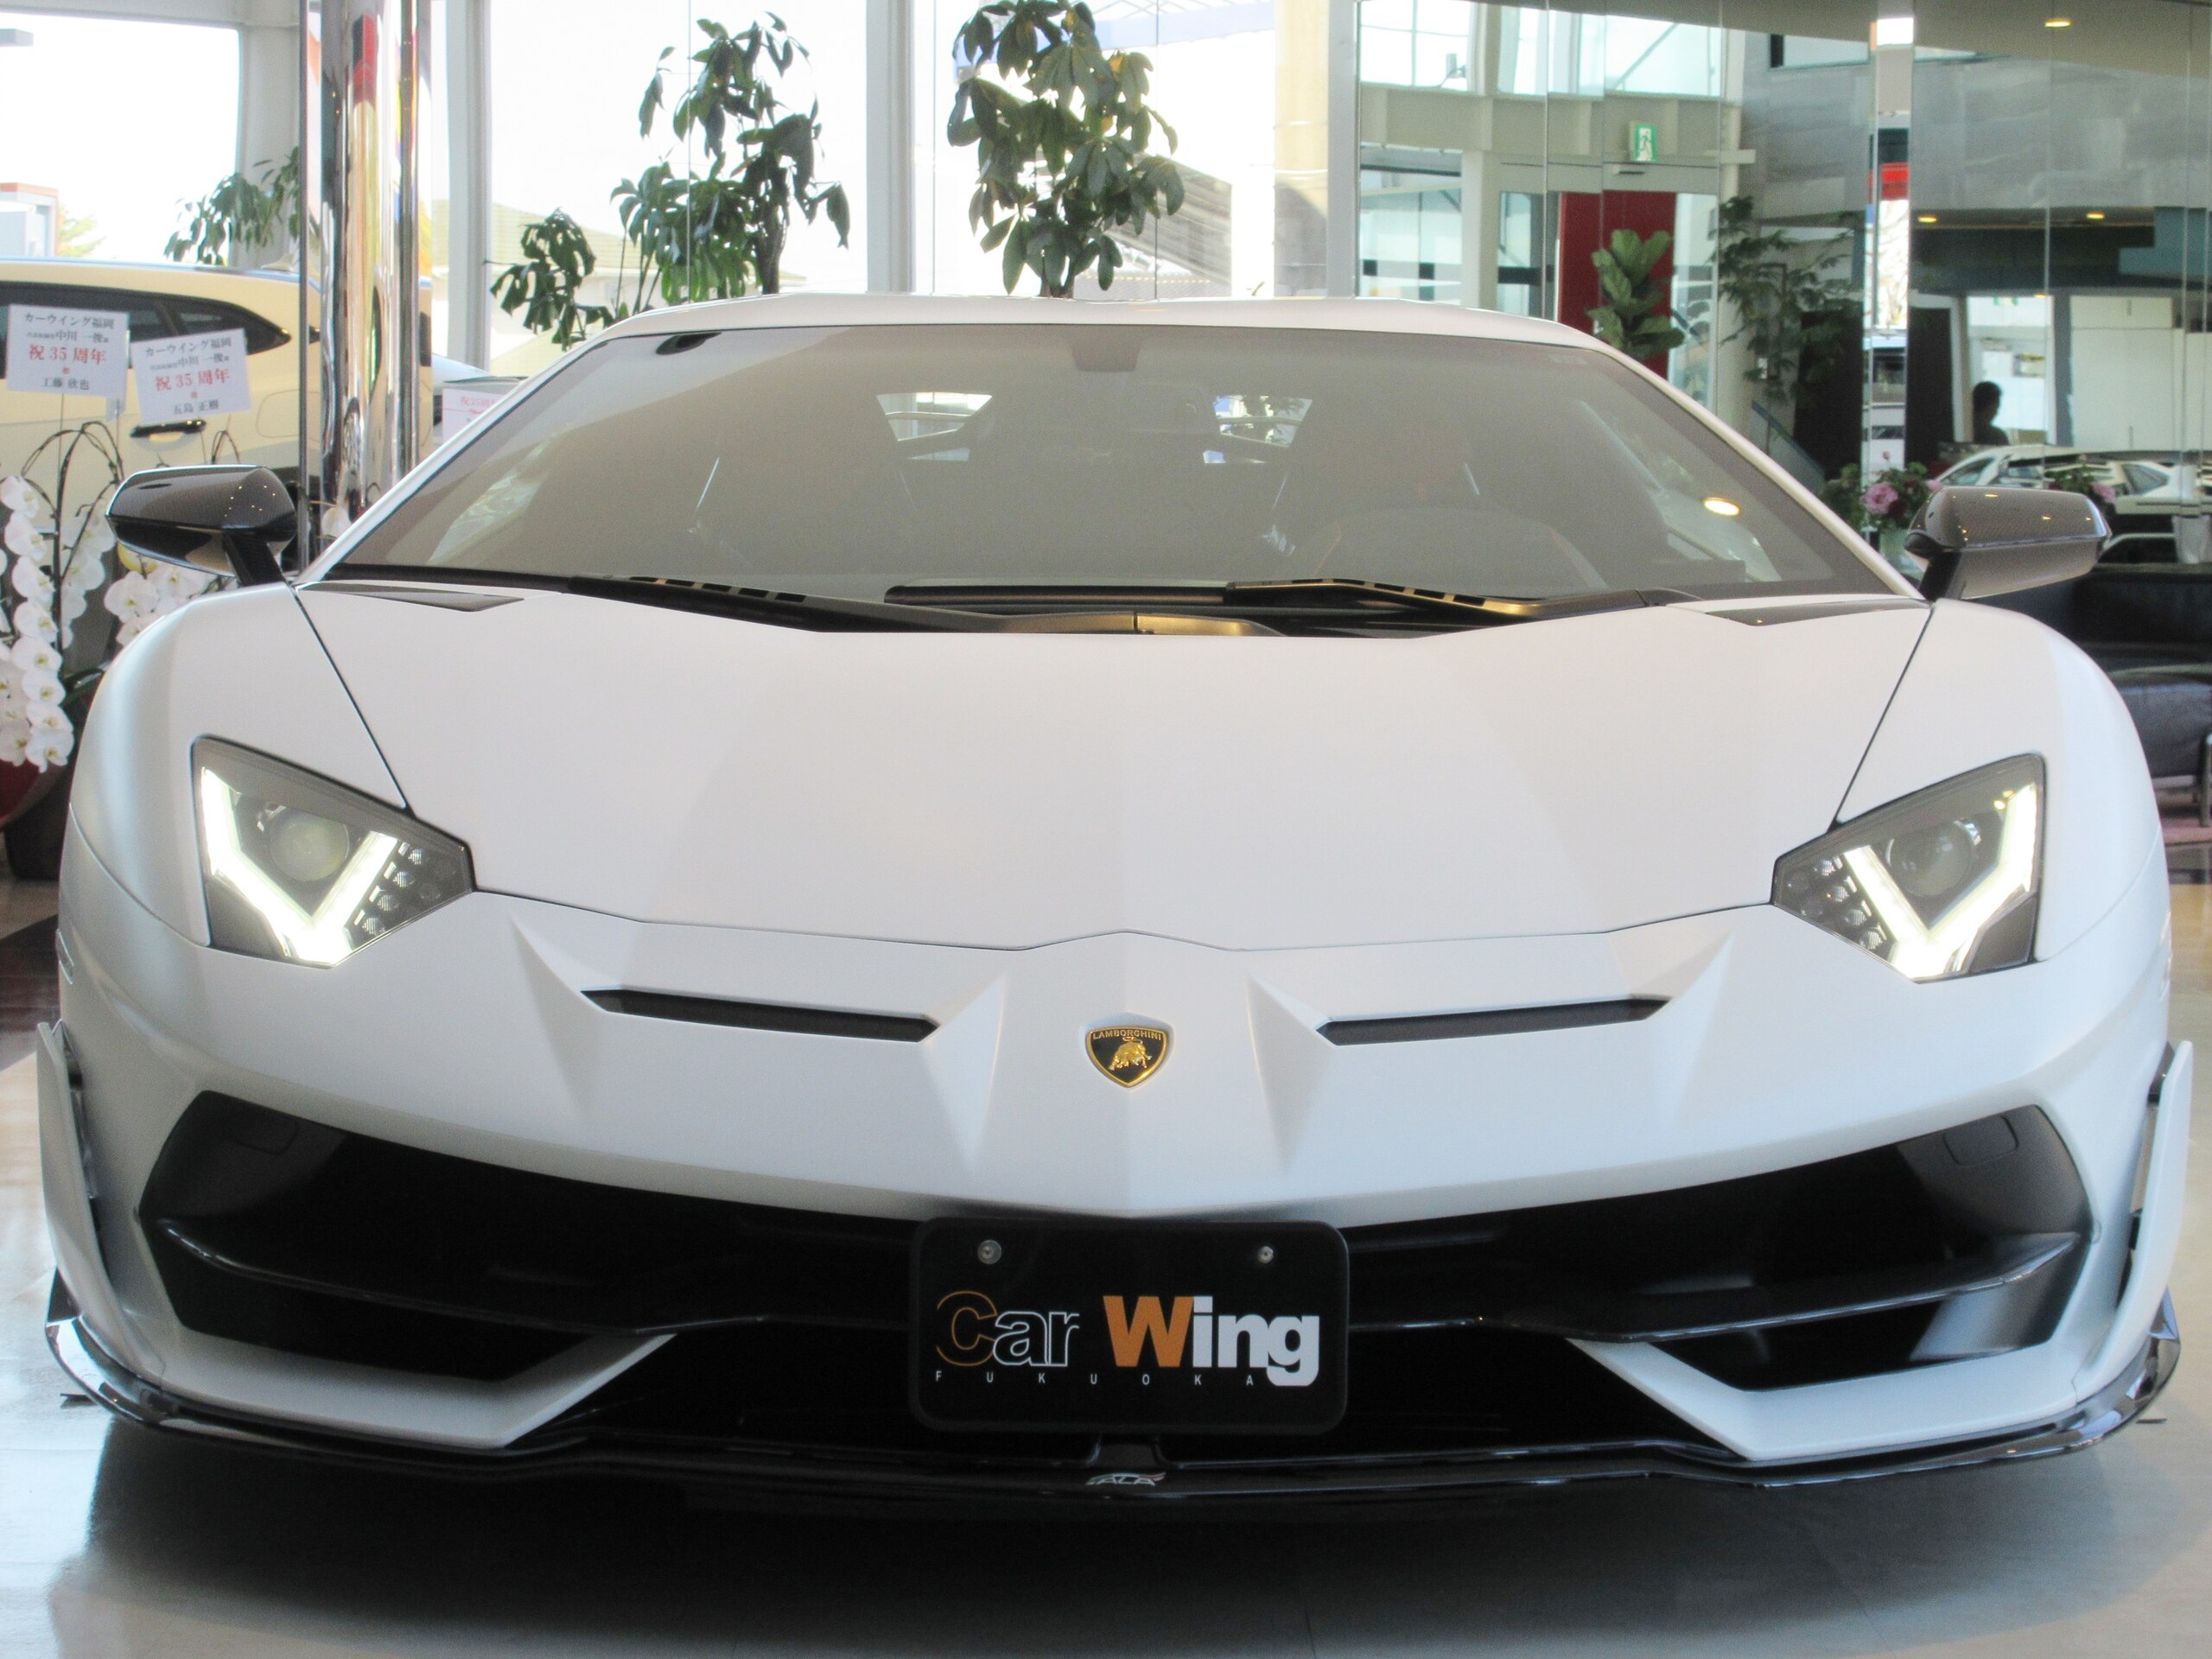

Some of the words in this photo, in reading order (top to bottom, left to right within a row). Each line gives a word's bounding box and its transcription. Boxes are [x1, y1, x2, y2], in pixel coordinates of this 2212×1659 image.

[1093, 1029, 1161, 1040] LAMBORGHINI
[936, 1290, 1080, 1367] Car
[1103, 1295, 1320, 1387] Wing
[935, 1370, 1255, 1387] FUKUOKA
